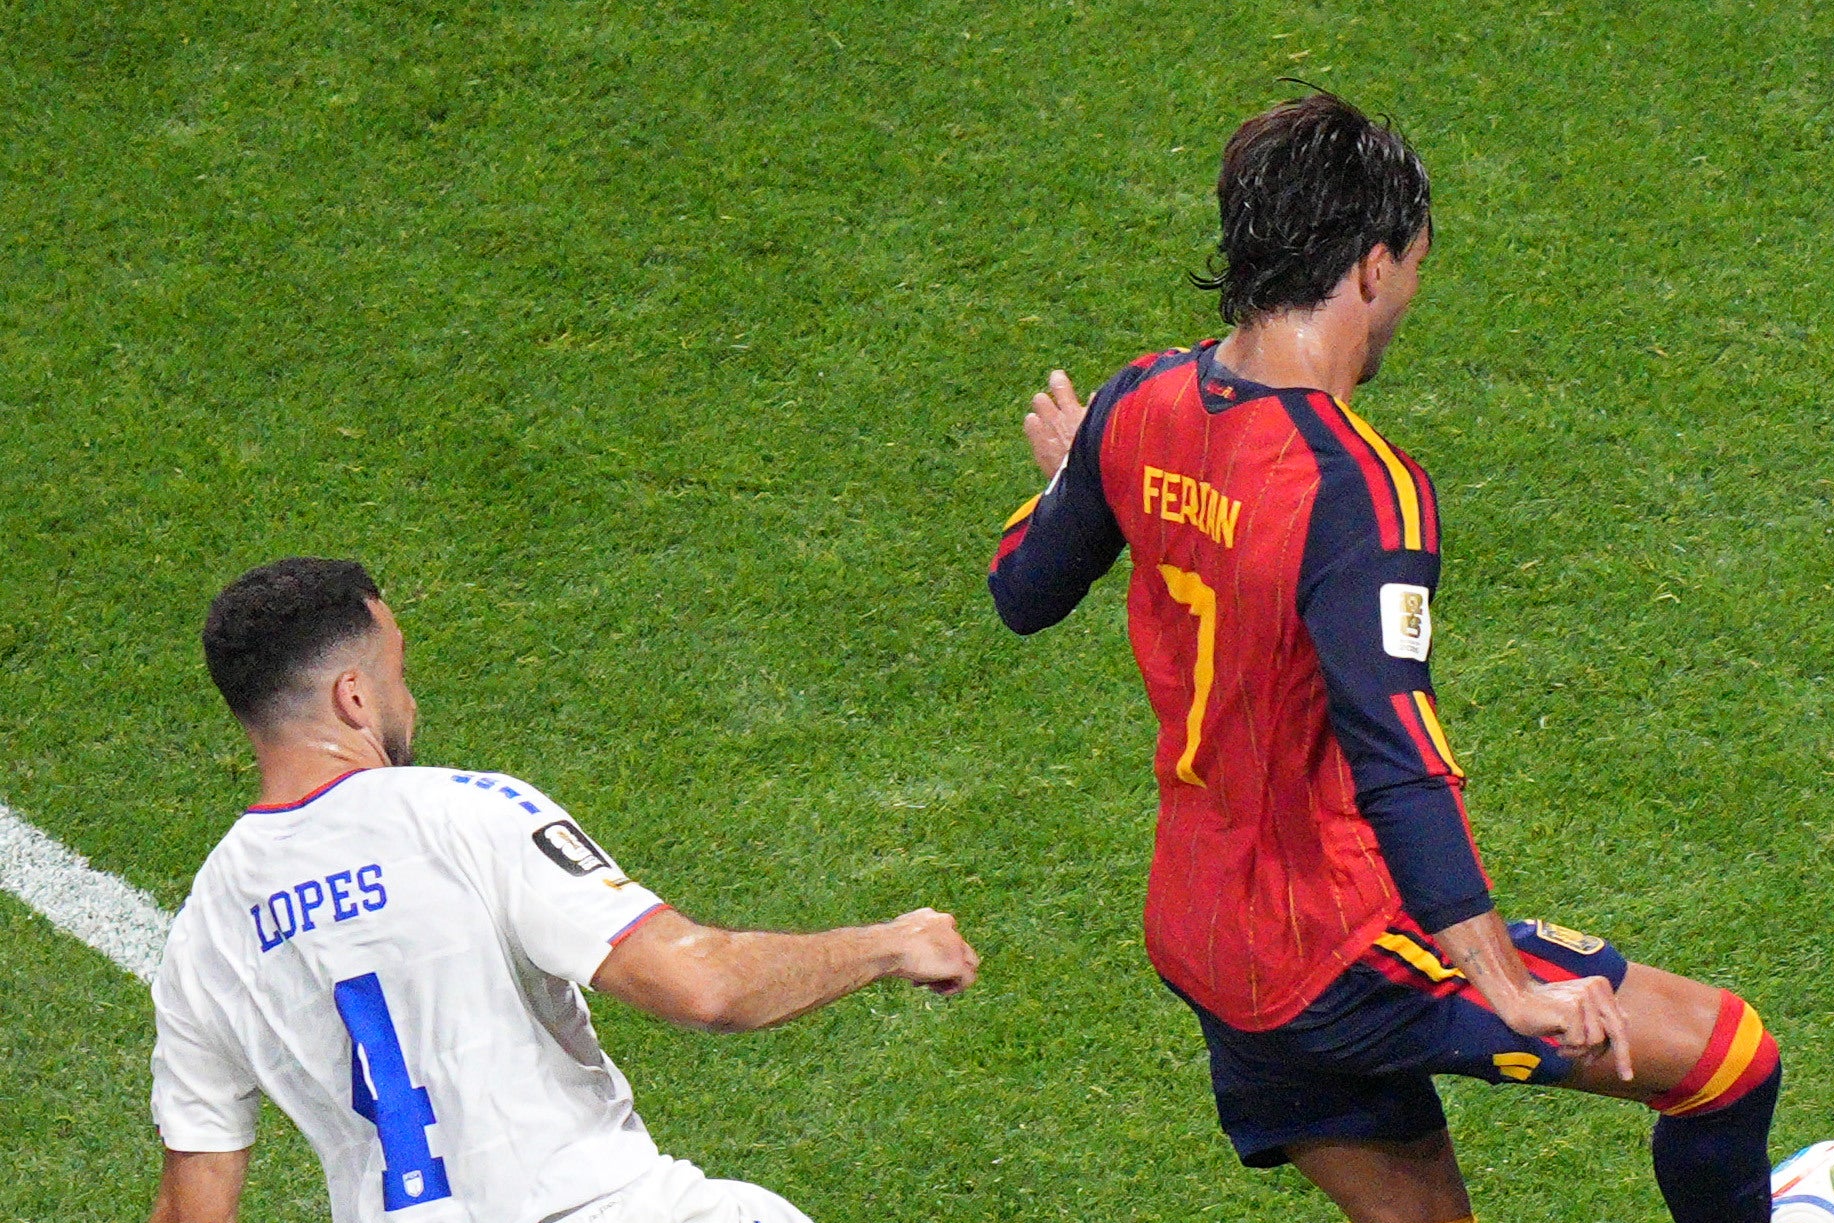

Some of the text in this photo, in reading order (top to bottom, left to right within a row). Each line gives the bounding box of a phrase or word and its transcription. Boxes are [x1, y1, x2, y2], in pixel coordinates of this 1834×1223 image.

[1157, 563, 1217, 788] 7
[250, 863, 388, 953] LOPES
[334, 972, 452, 1212] 4
